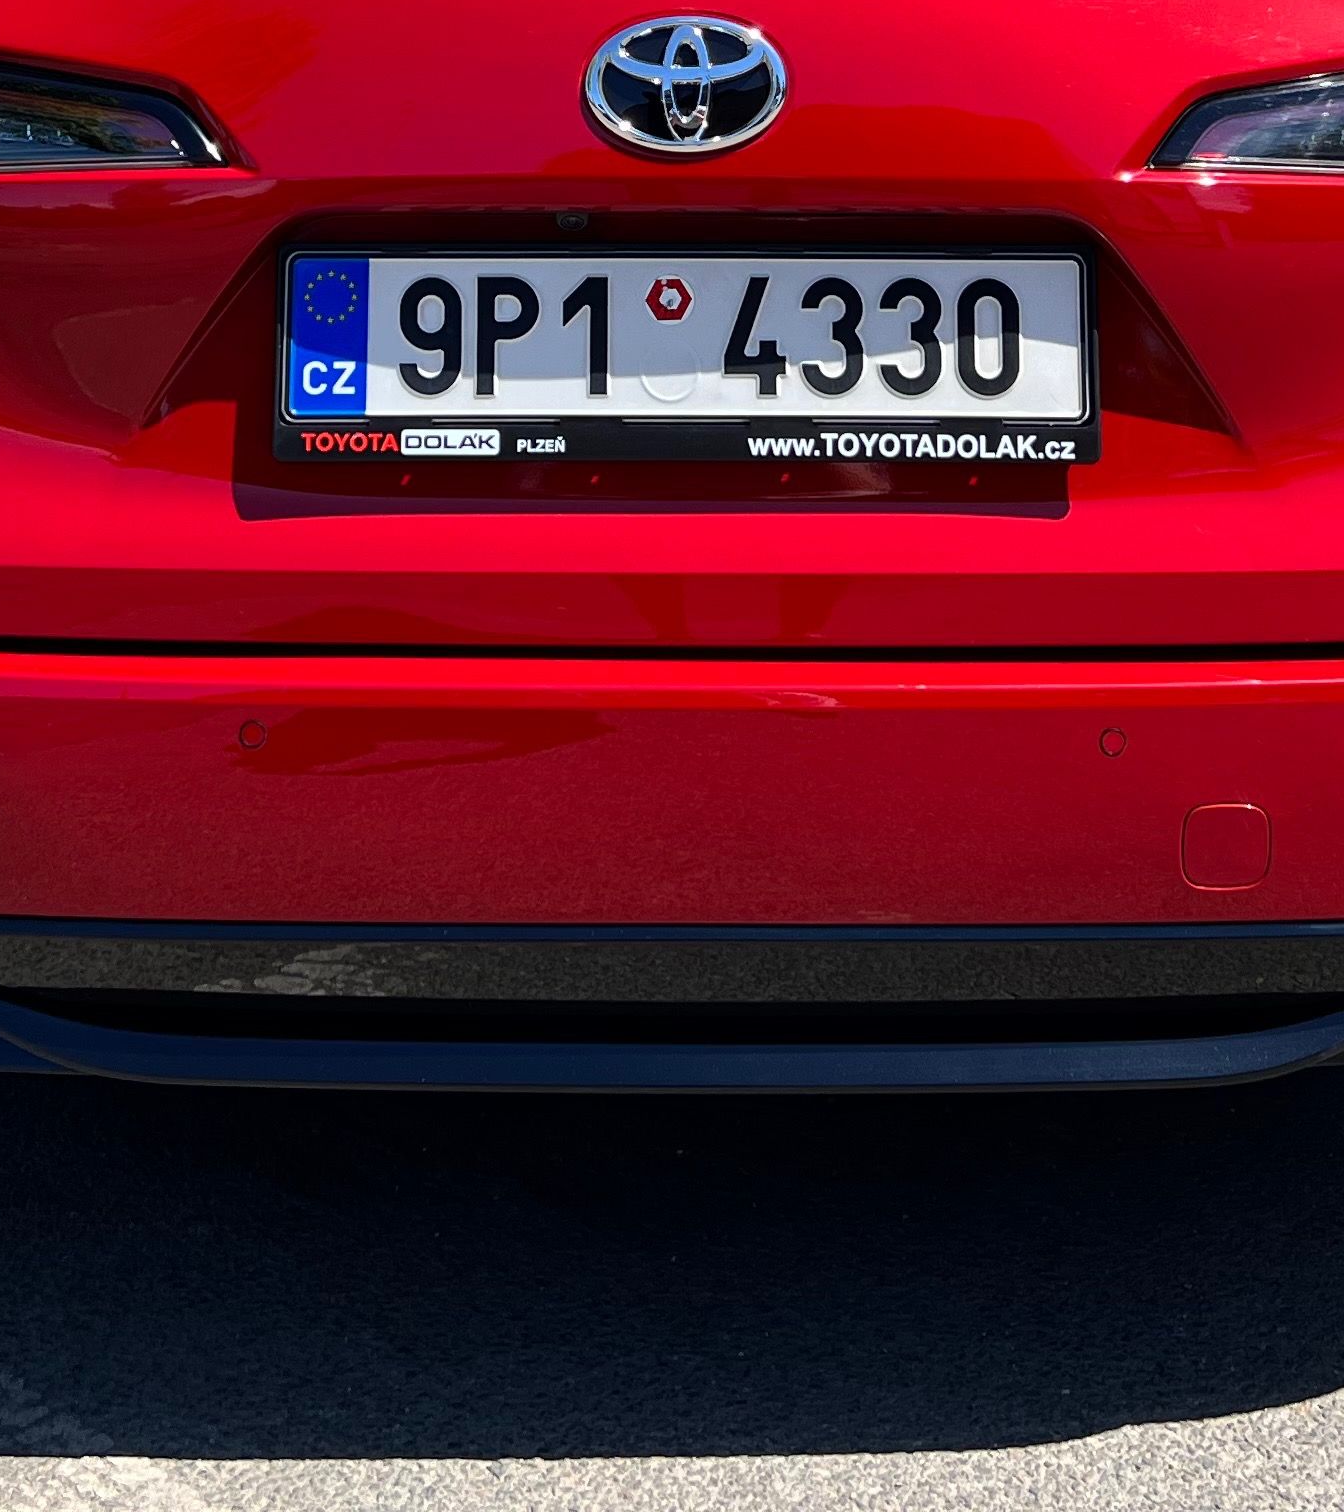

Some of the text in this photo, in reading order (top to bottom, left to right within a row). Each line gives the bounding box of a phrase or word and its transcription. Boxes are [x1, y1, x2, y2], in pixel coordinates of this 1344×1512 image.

[398, 275, 1022, 398] 9P1 4330
[302, 360, 356, 395] CZ
[301, 431, 566, 454] TOYOTA DOLÁK PLZEŇ
[748, 432, 1076, 460] www.TOYOTADOLAK.cz
